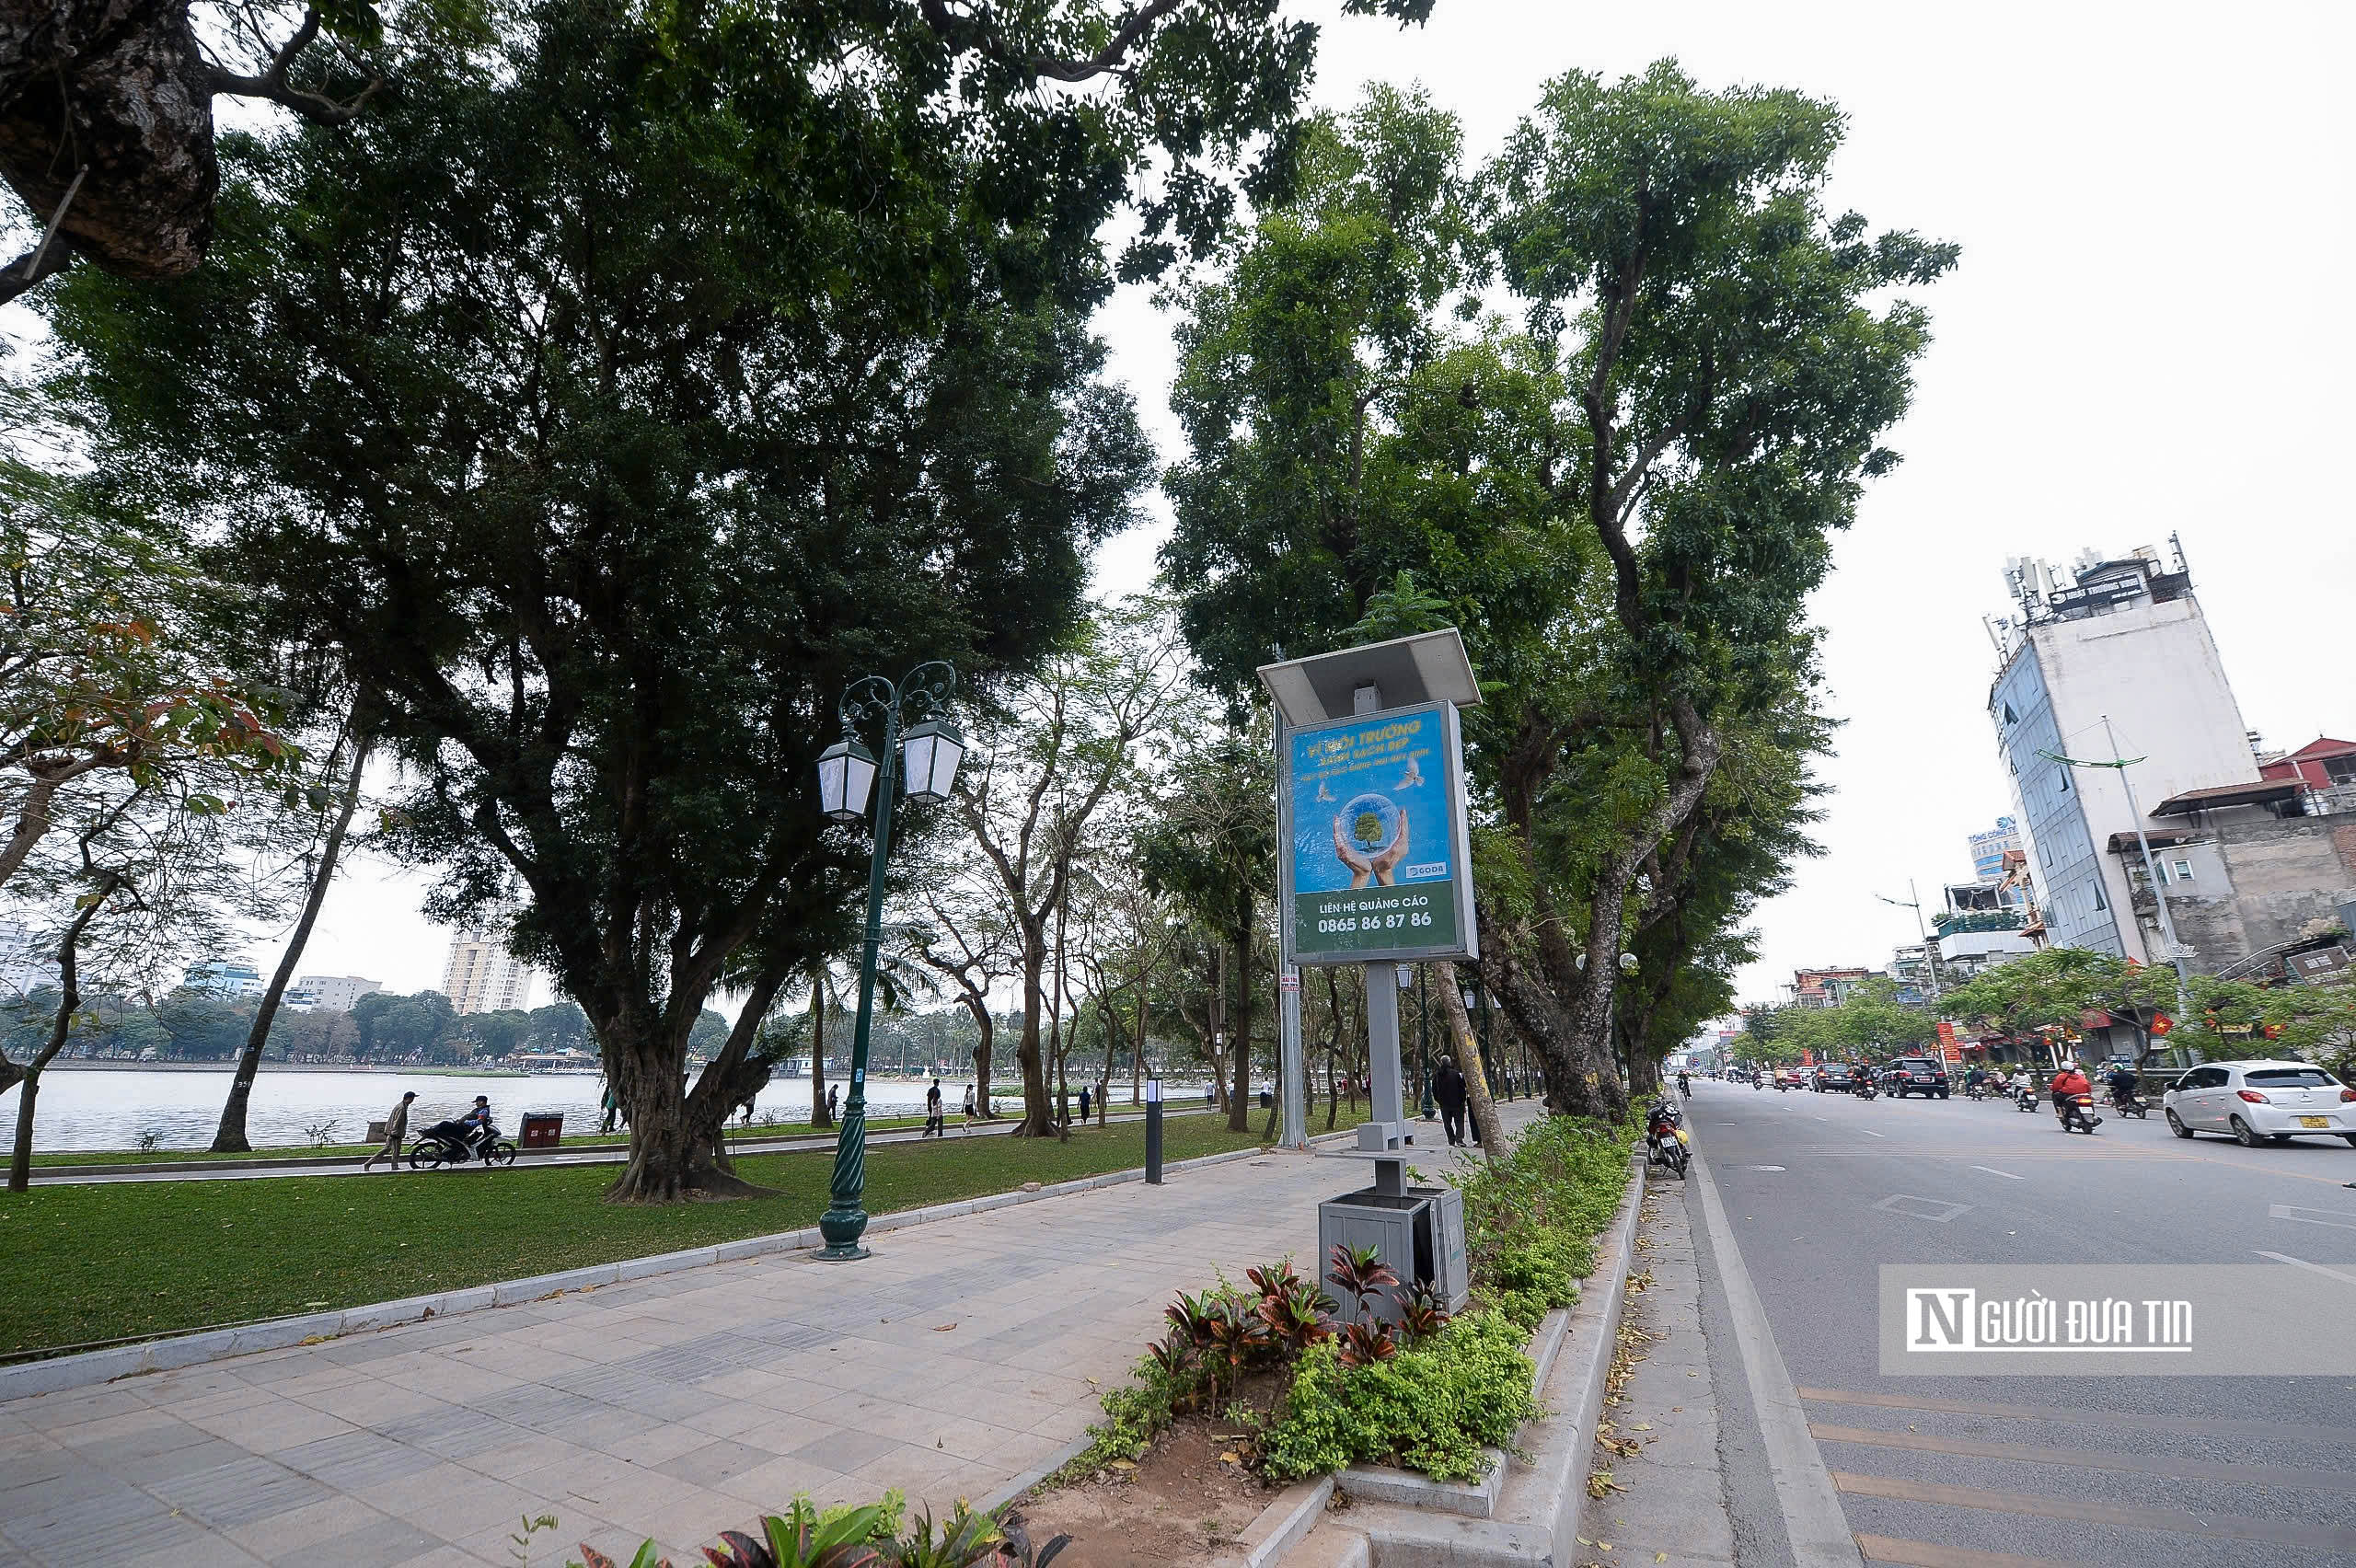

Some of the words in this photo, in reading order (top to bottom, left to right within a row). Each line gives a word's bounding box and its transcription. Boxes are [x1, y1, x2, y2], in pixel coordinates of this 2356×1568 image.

[1319, 902, 1340, 914] LIÊN
[1343, 901, 1357, 914] HỆ
[1359, 897, 1399, 911] QUẢNG
[1402, 894, 1428, 907] CÁO
[1318, 917, 1357, 933] 0865
[1361, 916, 1380, 930] 86
[1385, 914, 1405, 928] 87
[1411, 912, 1432, 927] 86
